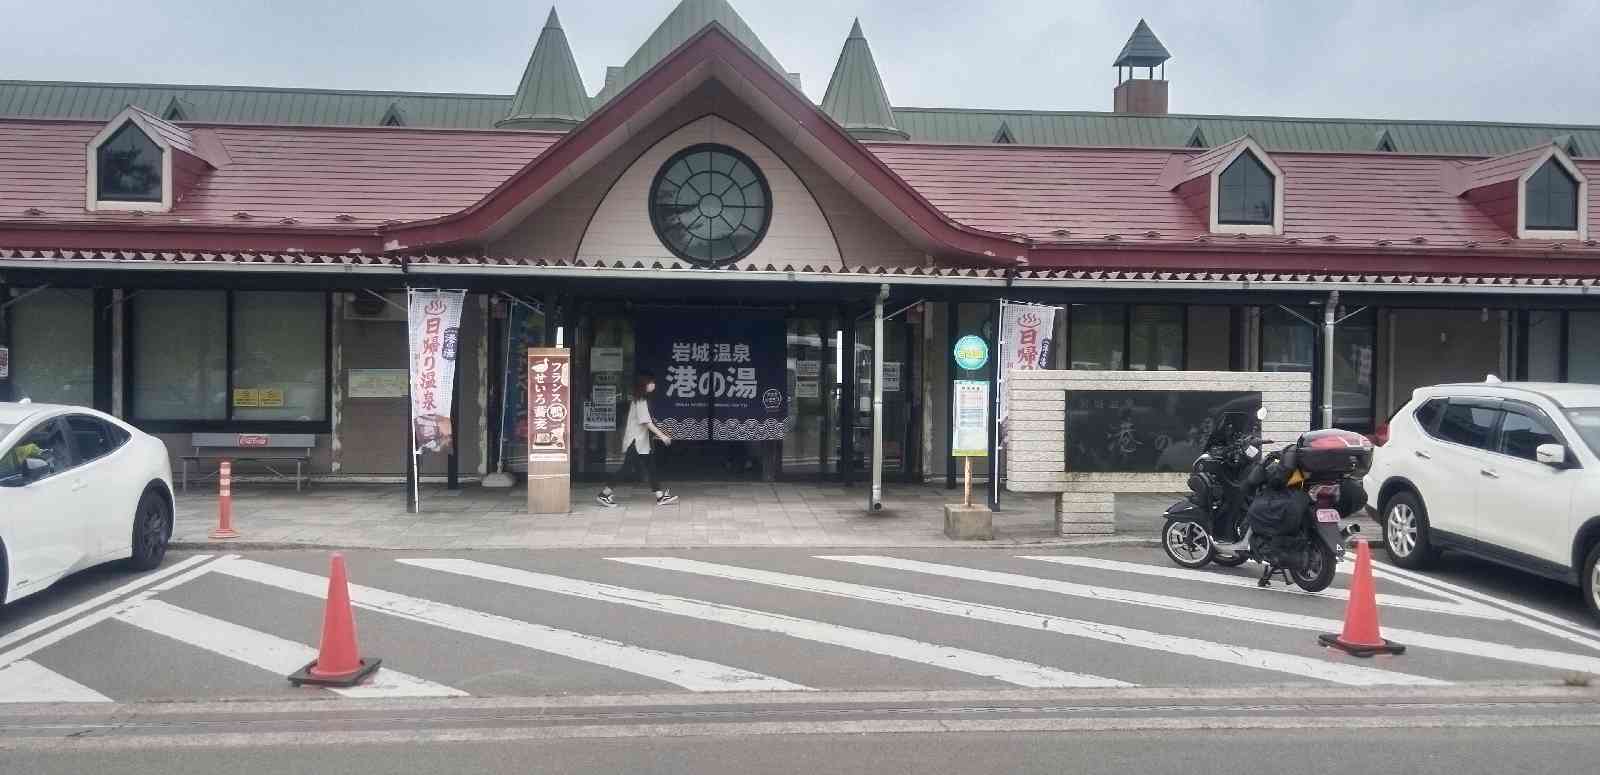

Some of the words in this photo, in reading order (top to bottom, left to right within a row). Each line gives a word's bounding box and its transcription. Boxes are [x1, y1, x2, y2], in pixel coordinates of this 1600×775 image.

[421, 318, 440, 411] 日帰り温泉
[672, 343, 751, 363] 岩城温泉
[665, 366, 758, 399] 港の湯
